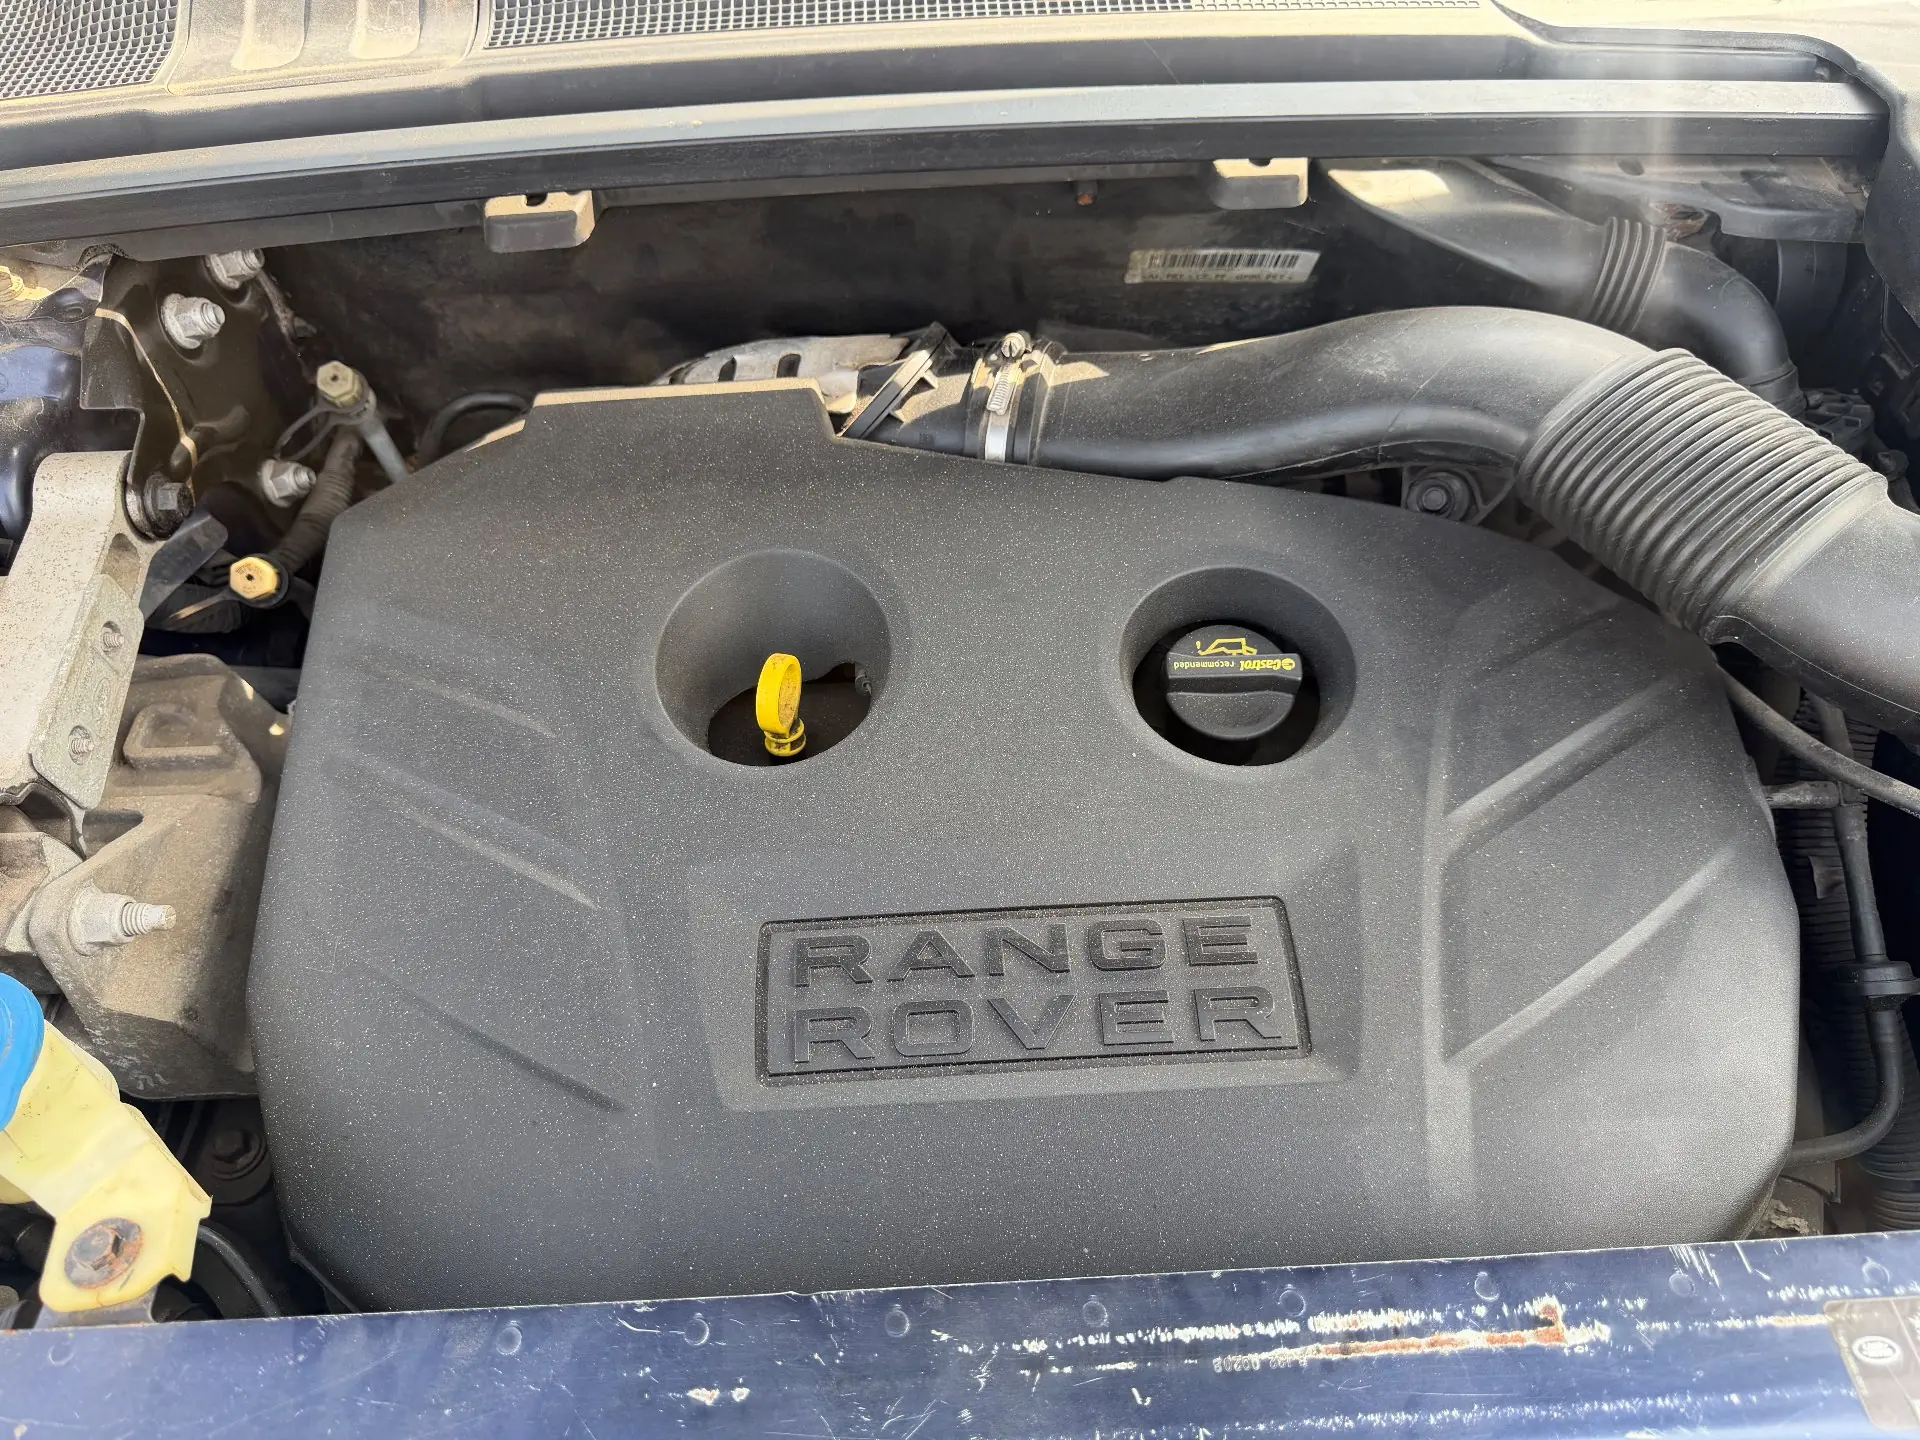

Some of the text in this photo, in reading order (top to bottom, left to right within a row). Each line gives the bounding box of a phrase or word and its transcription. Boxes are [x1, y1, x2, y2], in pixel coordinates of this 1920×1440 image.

[1173, 659, 1281, 671] Castrol recommended
[794, 915, 1258, 987] RANGE
[793, 986, 1282, 1063] ROVER
